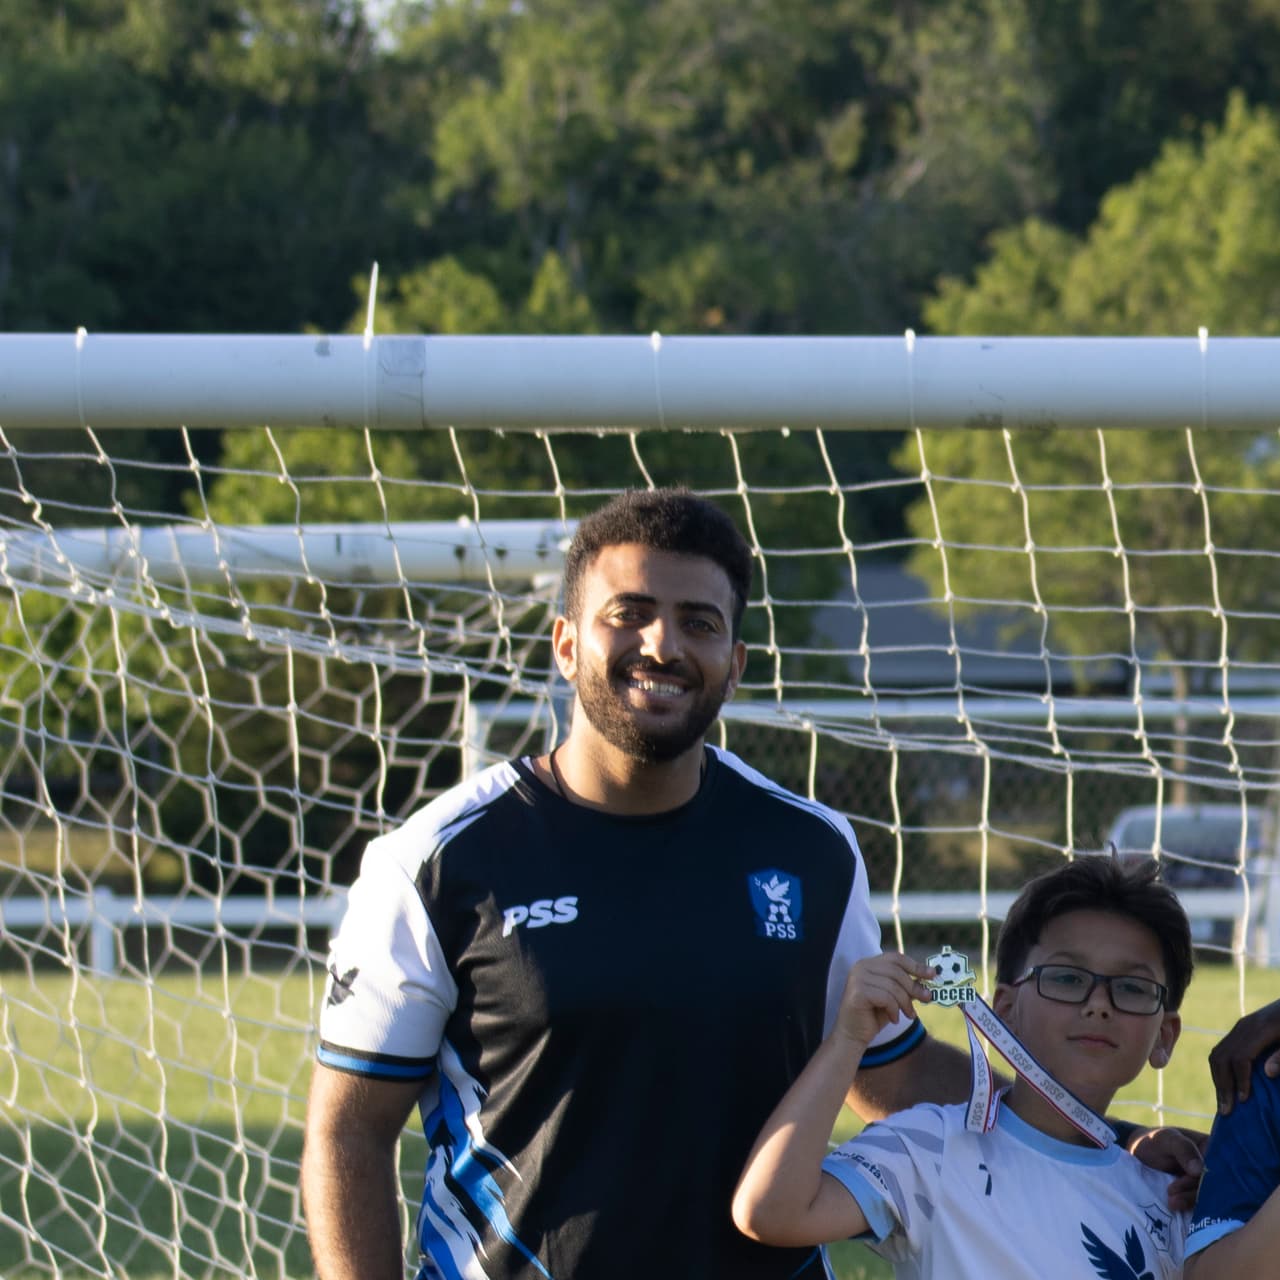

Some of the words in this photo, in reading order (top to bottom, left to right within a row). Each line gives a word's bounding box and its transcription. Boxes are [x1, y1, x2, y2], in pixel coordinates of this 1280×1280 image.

[502, 896, 579, 937] PSS
[764, 921, 797, 939] PSS
[930, 987, 975, 1002] OCCER
